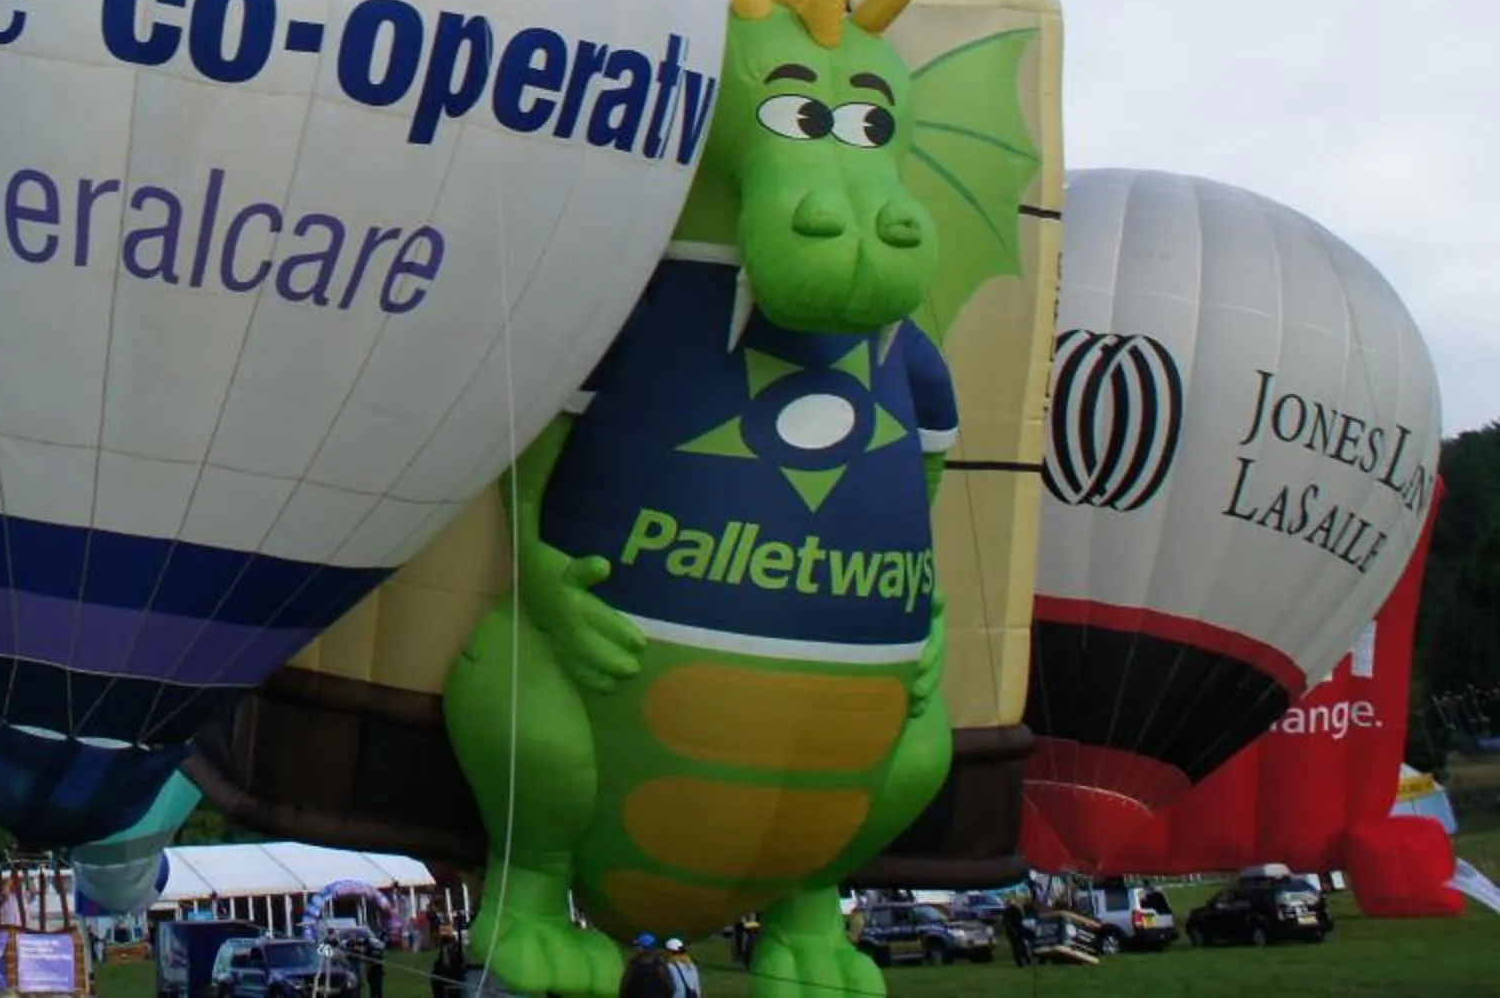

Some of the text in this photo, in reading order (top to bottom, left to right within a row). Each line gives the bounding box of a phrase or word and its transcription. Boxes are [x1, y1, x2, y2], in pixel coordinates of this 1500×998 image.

[1239, 368, 1385, 473] JONES
[619, 507, 934, 614] Palletways
[1268, 700, 1384, 740] ange.
